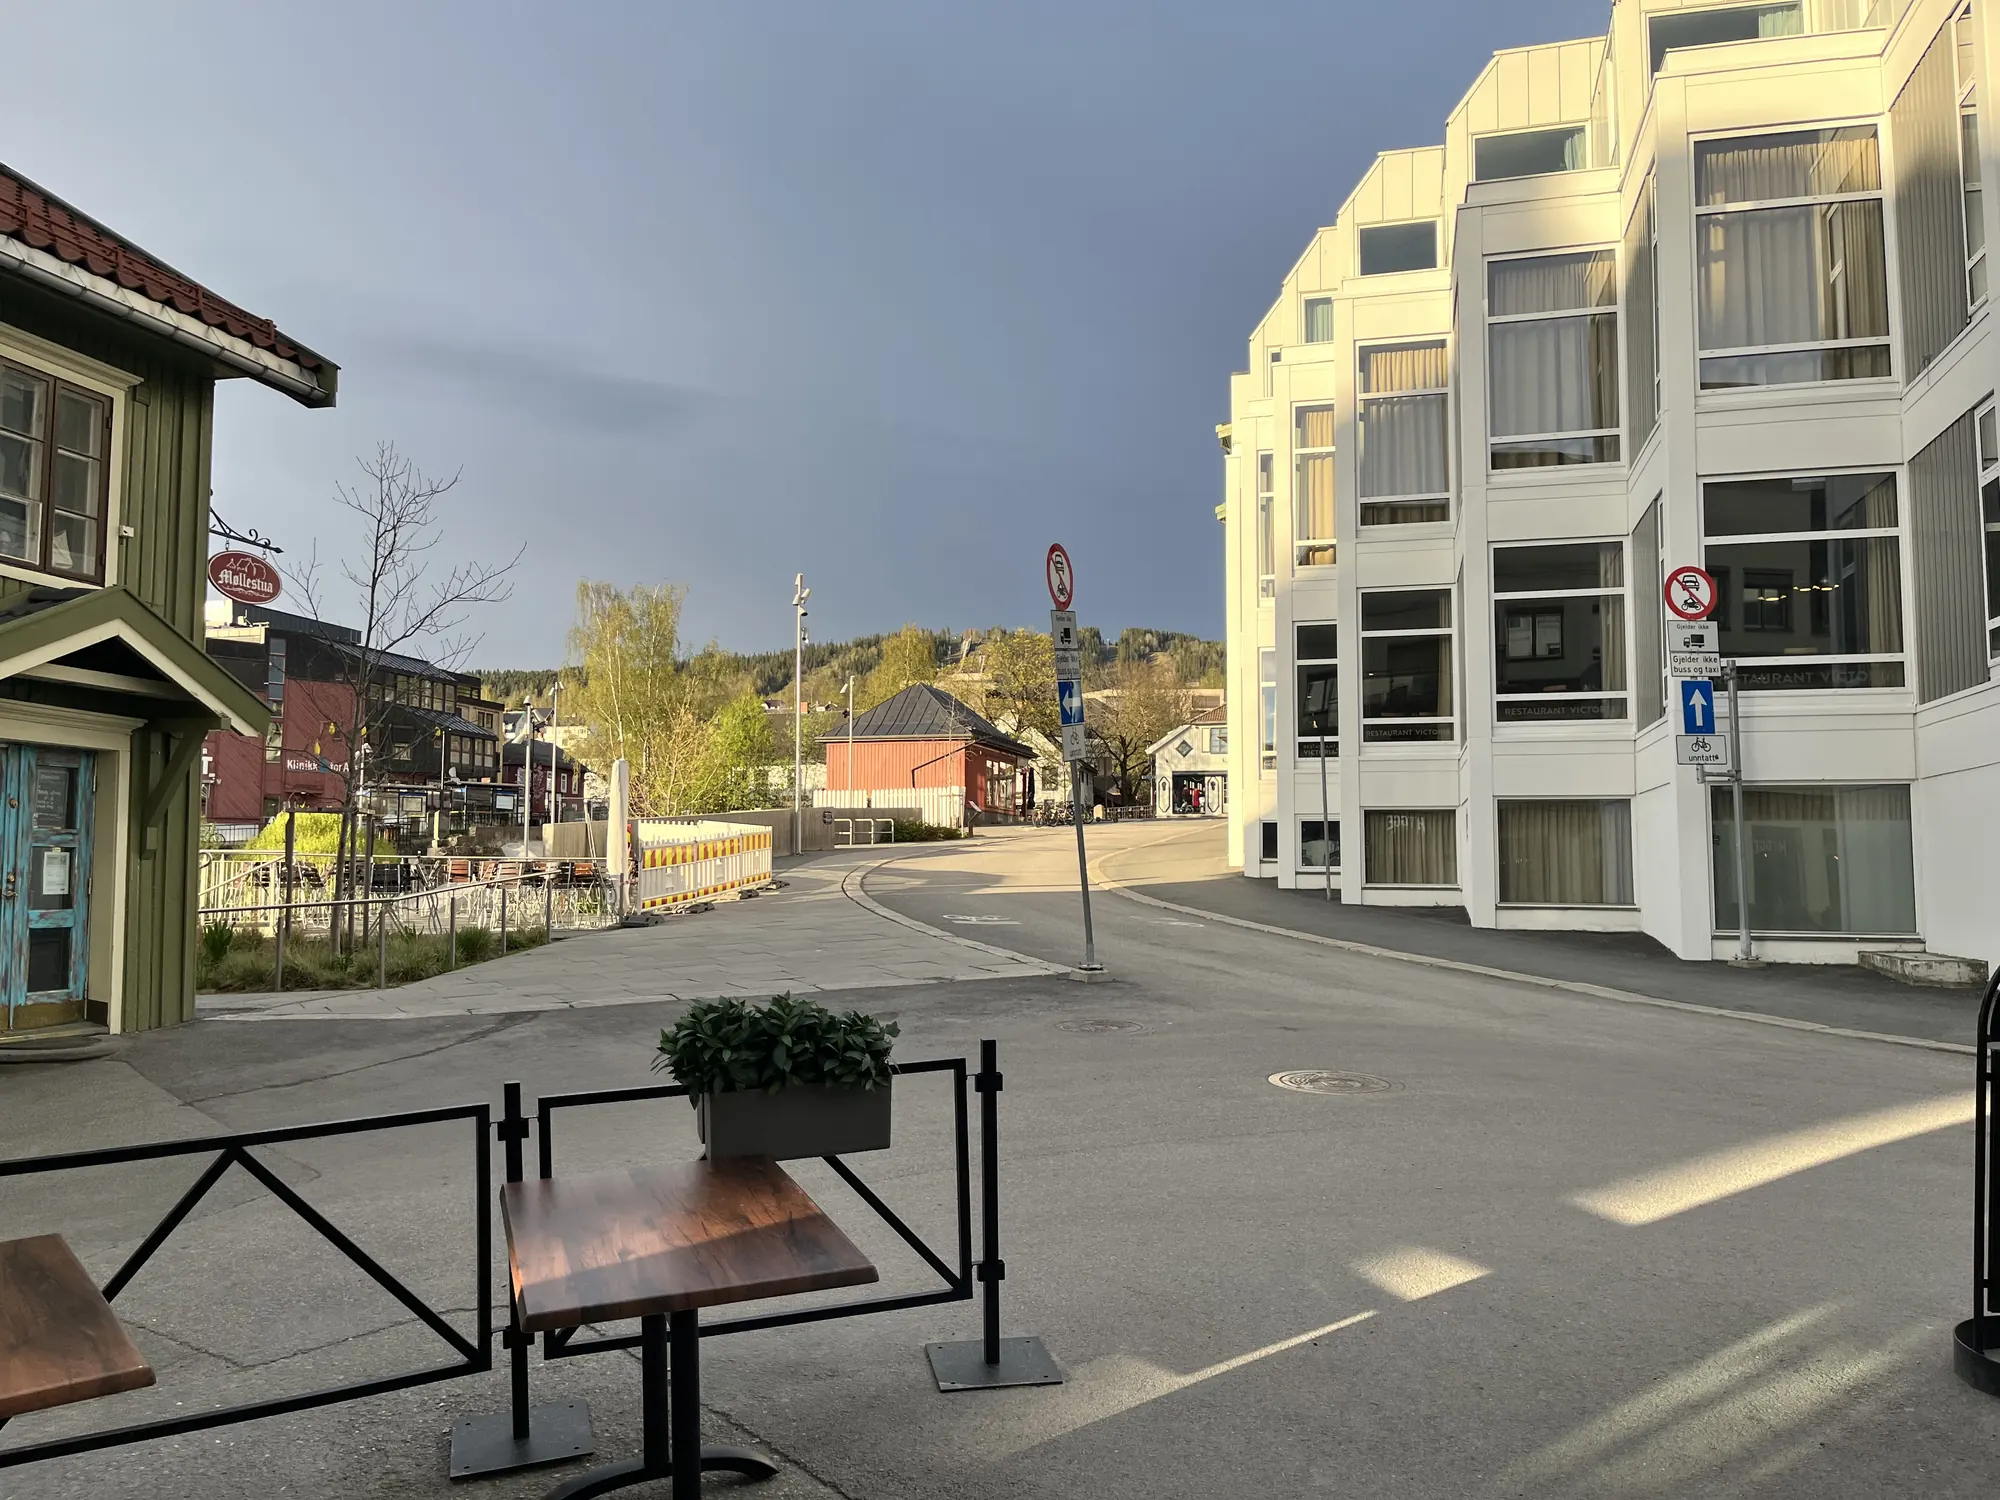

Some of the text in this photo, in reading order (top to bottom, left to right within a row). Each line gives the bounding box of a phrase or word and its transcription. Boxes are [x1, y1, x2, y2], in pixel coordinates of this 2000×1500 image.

[1676, 623, 1696, 631] Gjelder
[1672, 655, 1718, 665] Gjelder ikke
[1673, 665, 1692, 673] buss
[1693, 666, 1703, 675] og
[1504, 706, 1566, 716] RESTAURANT
[1366, 729, 1412, 737] RESTAURANT
[1688, 754, 1716, 762] unntatt
[287, 759, 318, 771] Klinikk
